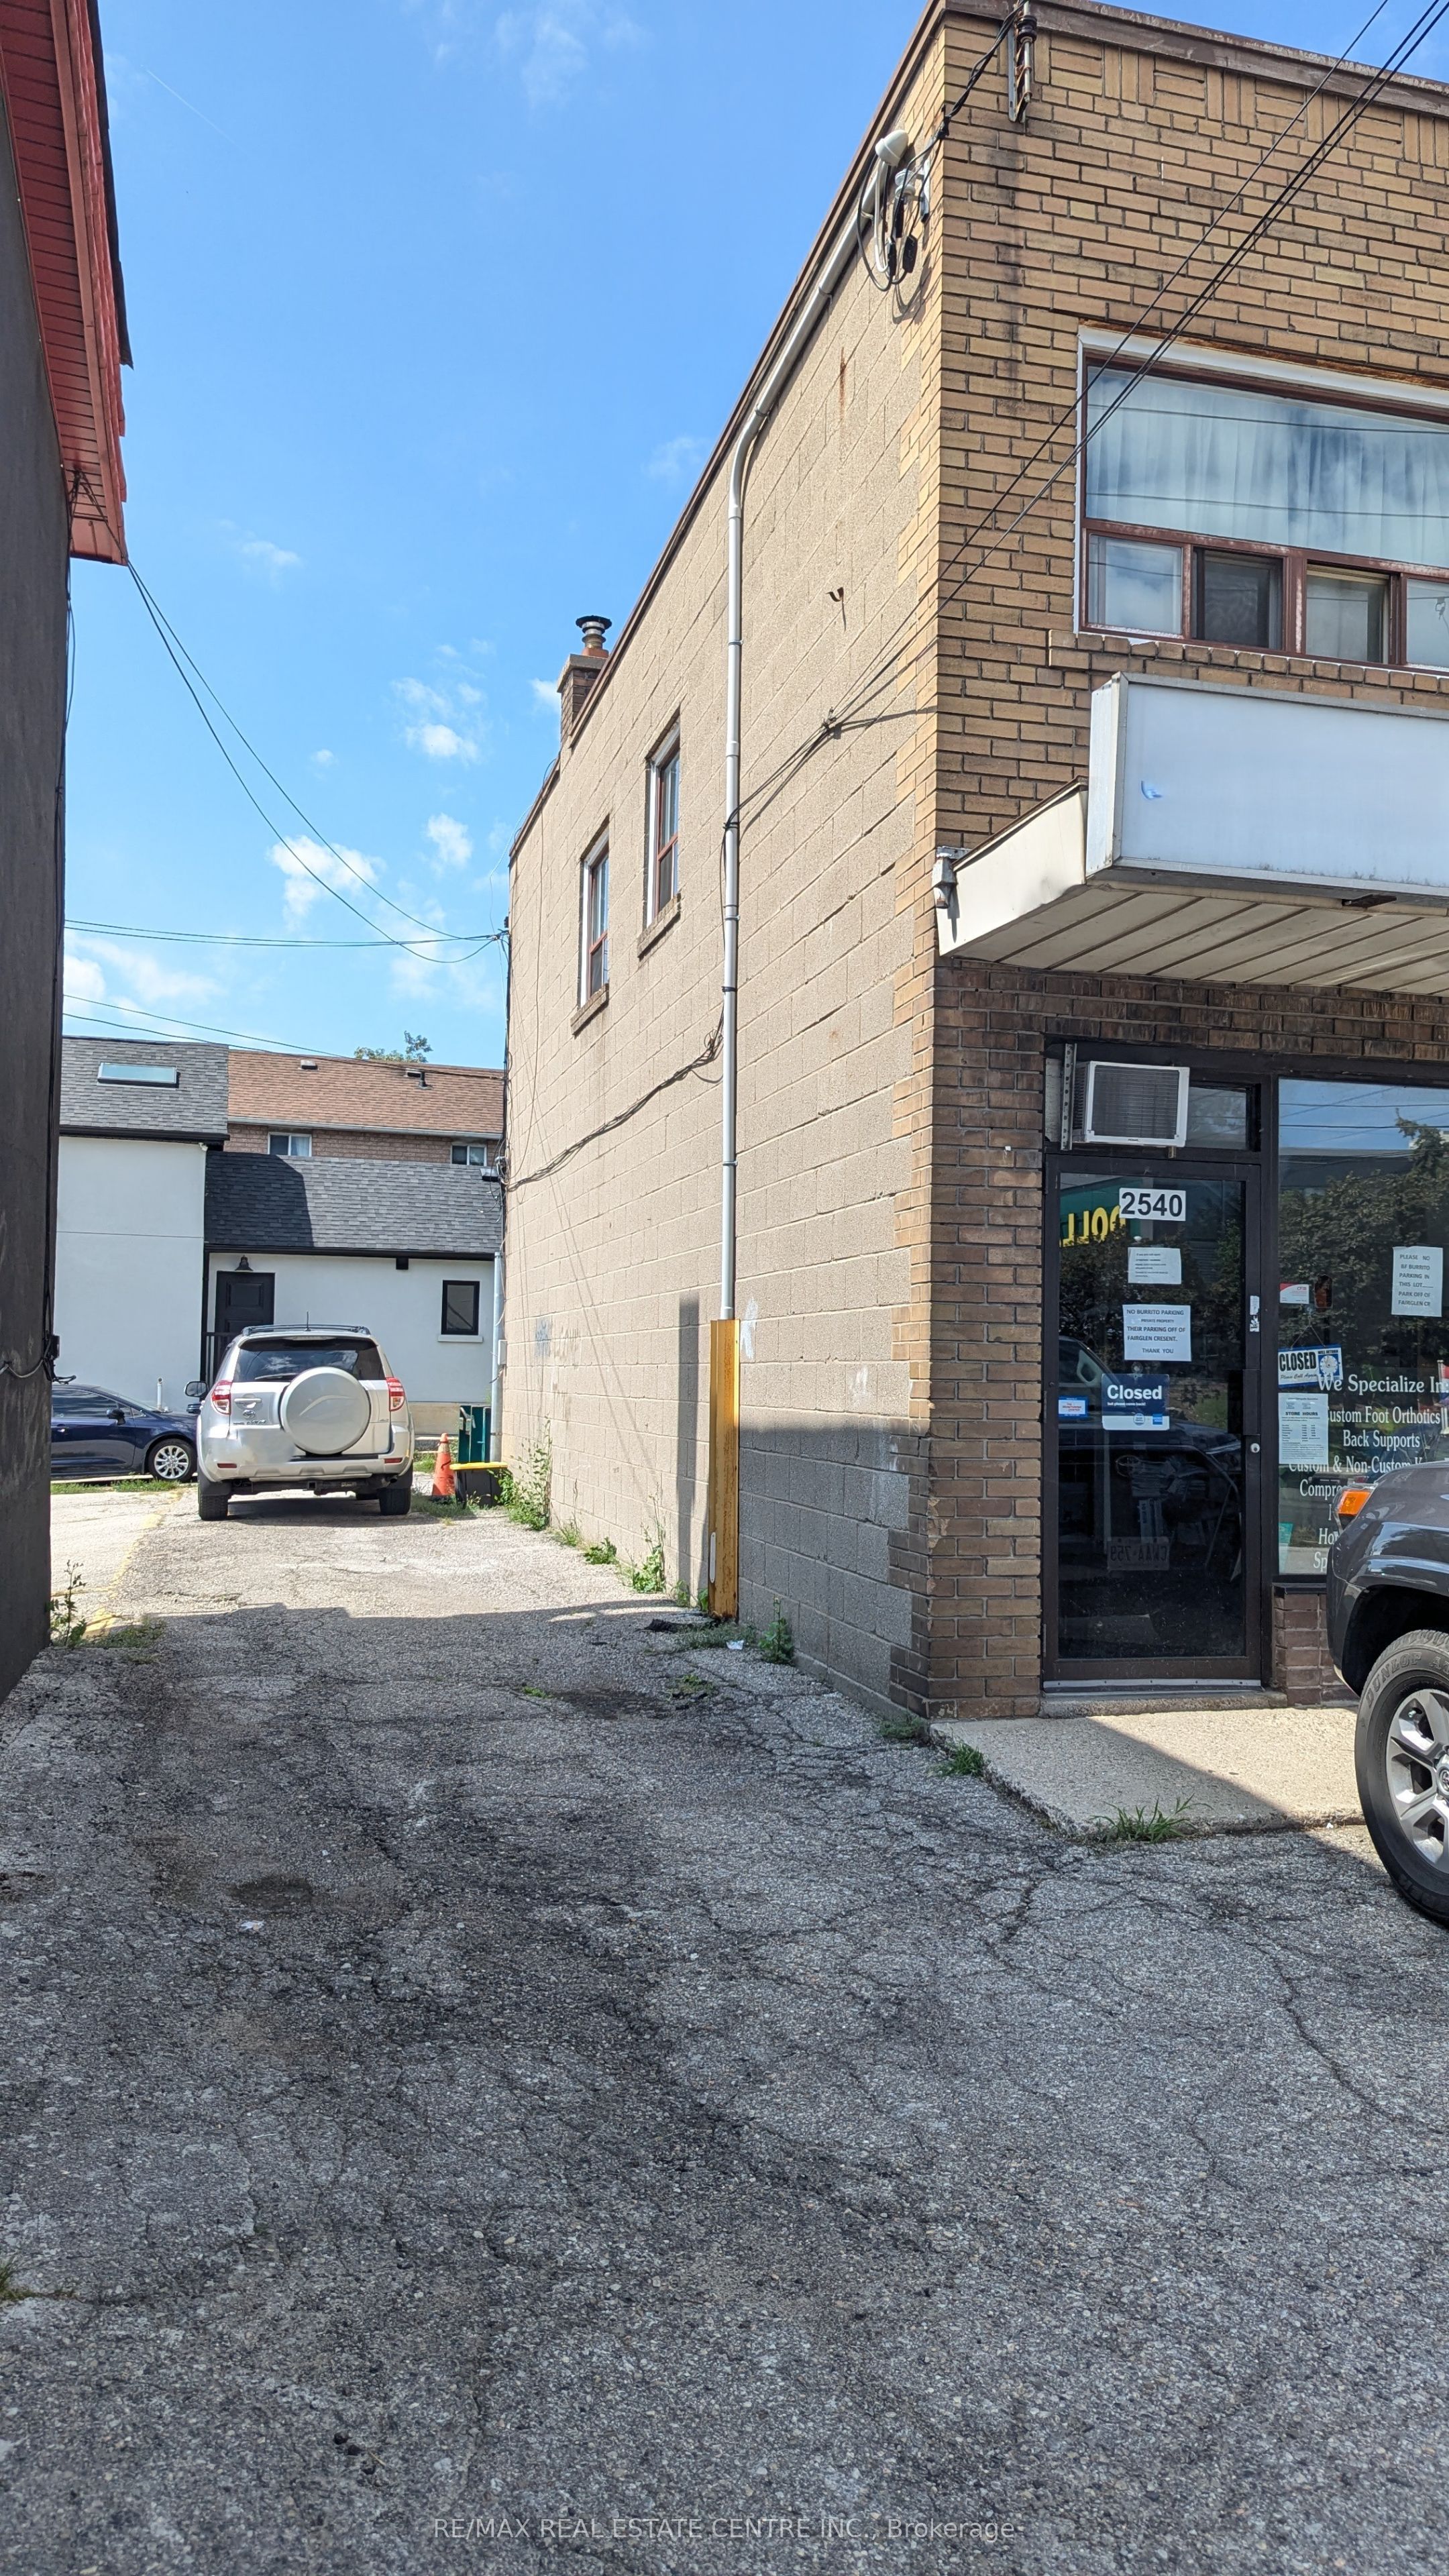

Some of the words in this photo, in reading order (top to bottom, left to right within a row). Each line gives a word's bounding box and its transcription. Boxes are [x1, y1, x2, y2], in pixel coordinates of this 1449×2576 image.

[1121, 1192, 1183, 1217] 2540
[1279, 1352, 1317, 1371] CLOSED
[1108, 1385, 1162, 1399] Closed
[1318, 1373, 1342, 1391] We
[1348, 1374, 1425, 1395] Specialize
[1328, 1406, 1362, 1423] ustom
[1365, 1406, 1390, 1424] Foot
[1393, 1406, 1441, 1425] Orthotics
[1343, 1430, 1369, 1447] Back
[1373, 1430, 1420, 1451] Supports
[1333, 1455, 1342, 1472] &
[1346, 1456, 1411, 1474] Non-Custo
[1366, 1652, 1422, 1709] DUNLOP
